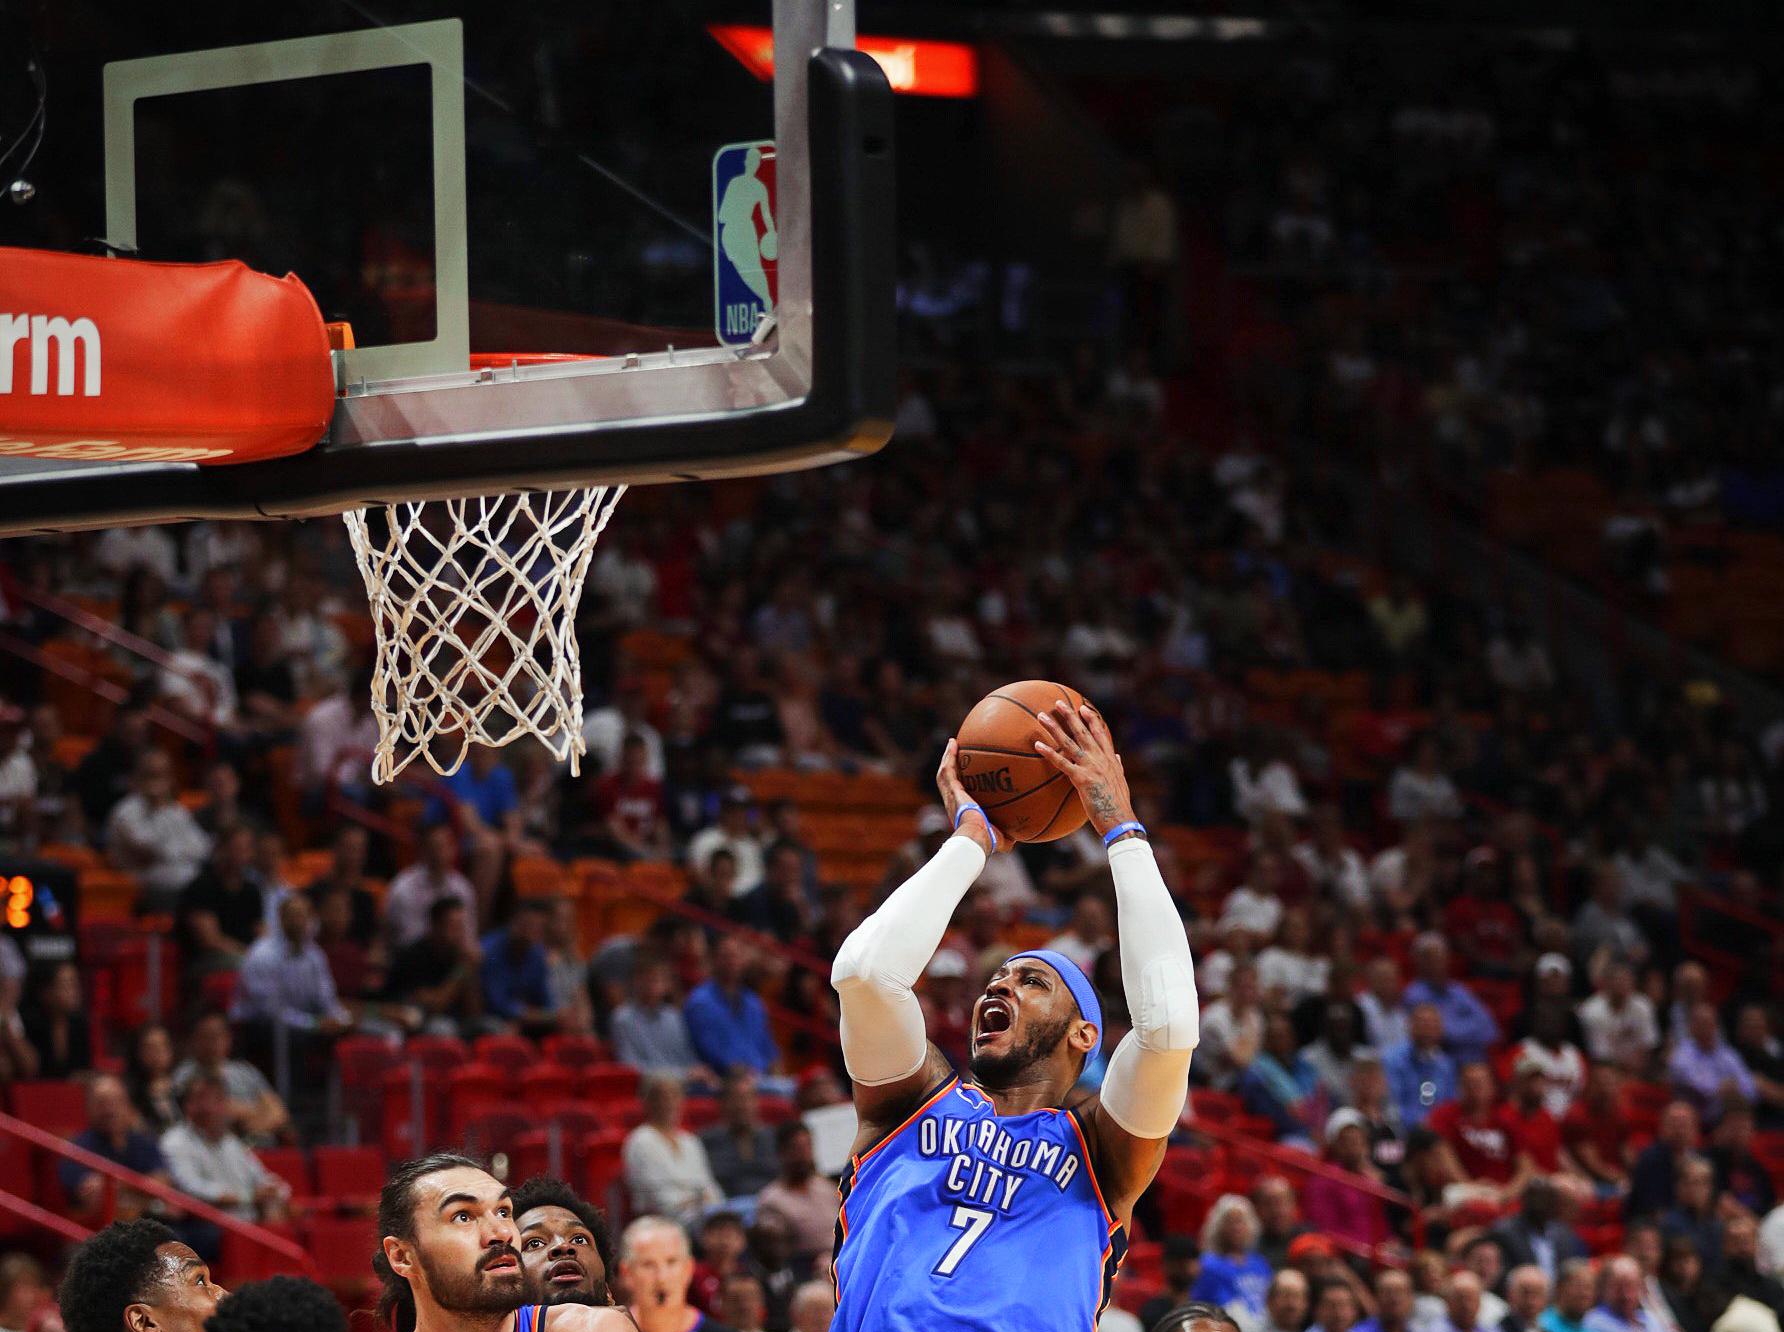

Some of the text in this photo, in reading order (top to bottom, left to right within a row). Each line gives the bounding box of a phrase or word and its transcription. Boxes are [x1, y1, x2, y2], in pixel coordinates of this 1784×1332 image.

[0, 312, 101, 397] rm
[947, 1154, 1023, 1210] CITY
[935, 1206, 997, 1277] 7
